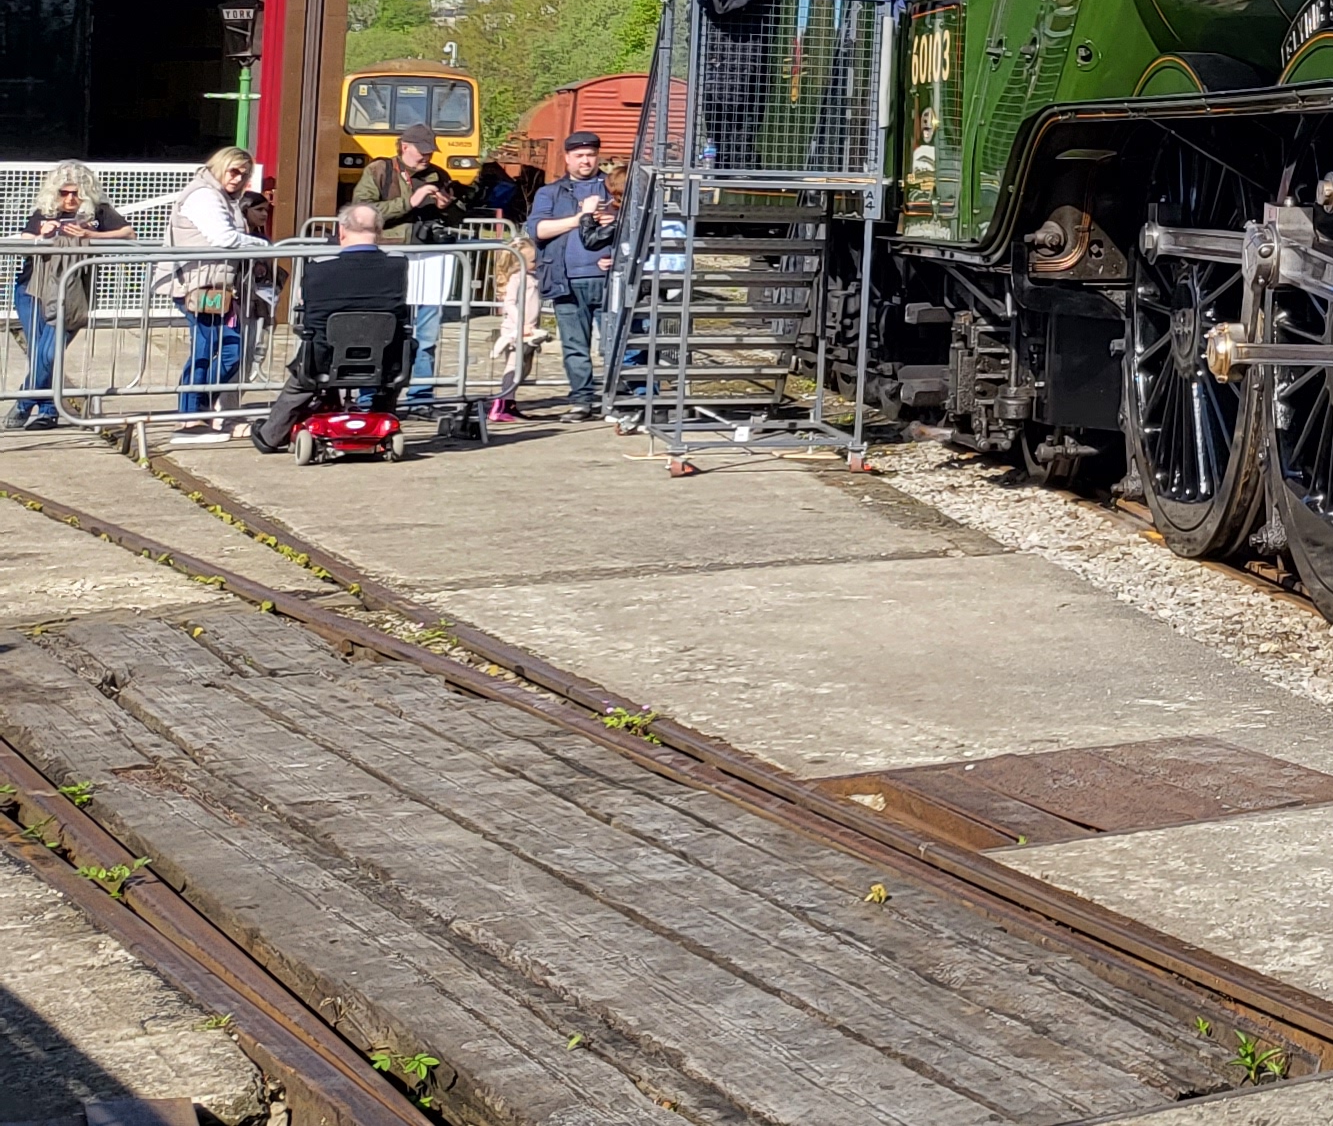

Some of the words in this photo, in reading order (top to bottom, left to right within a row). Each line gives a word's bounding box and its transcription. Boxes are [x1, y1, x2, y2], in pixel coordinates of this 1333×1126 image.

[225, 10, 251, 19] YORK
[911, 29, 950, 85] 60103
[865, 190, 874, 199] A
[865, 201, 875, 210] 4
